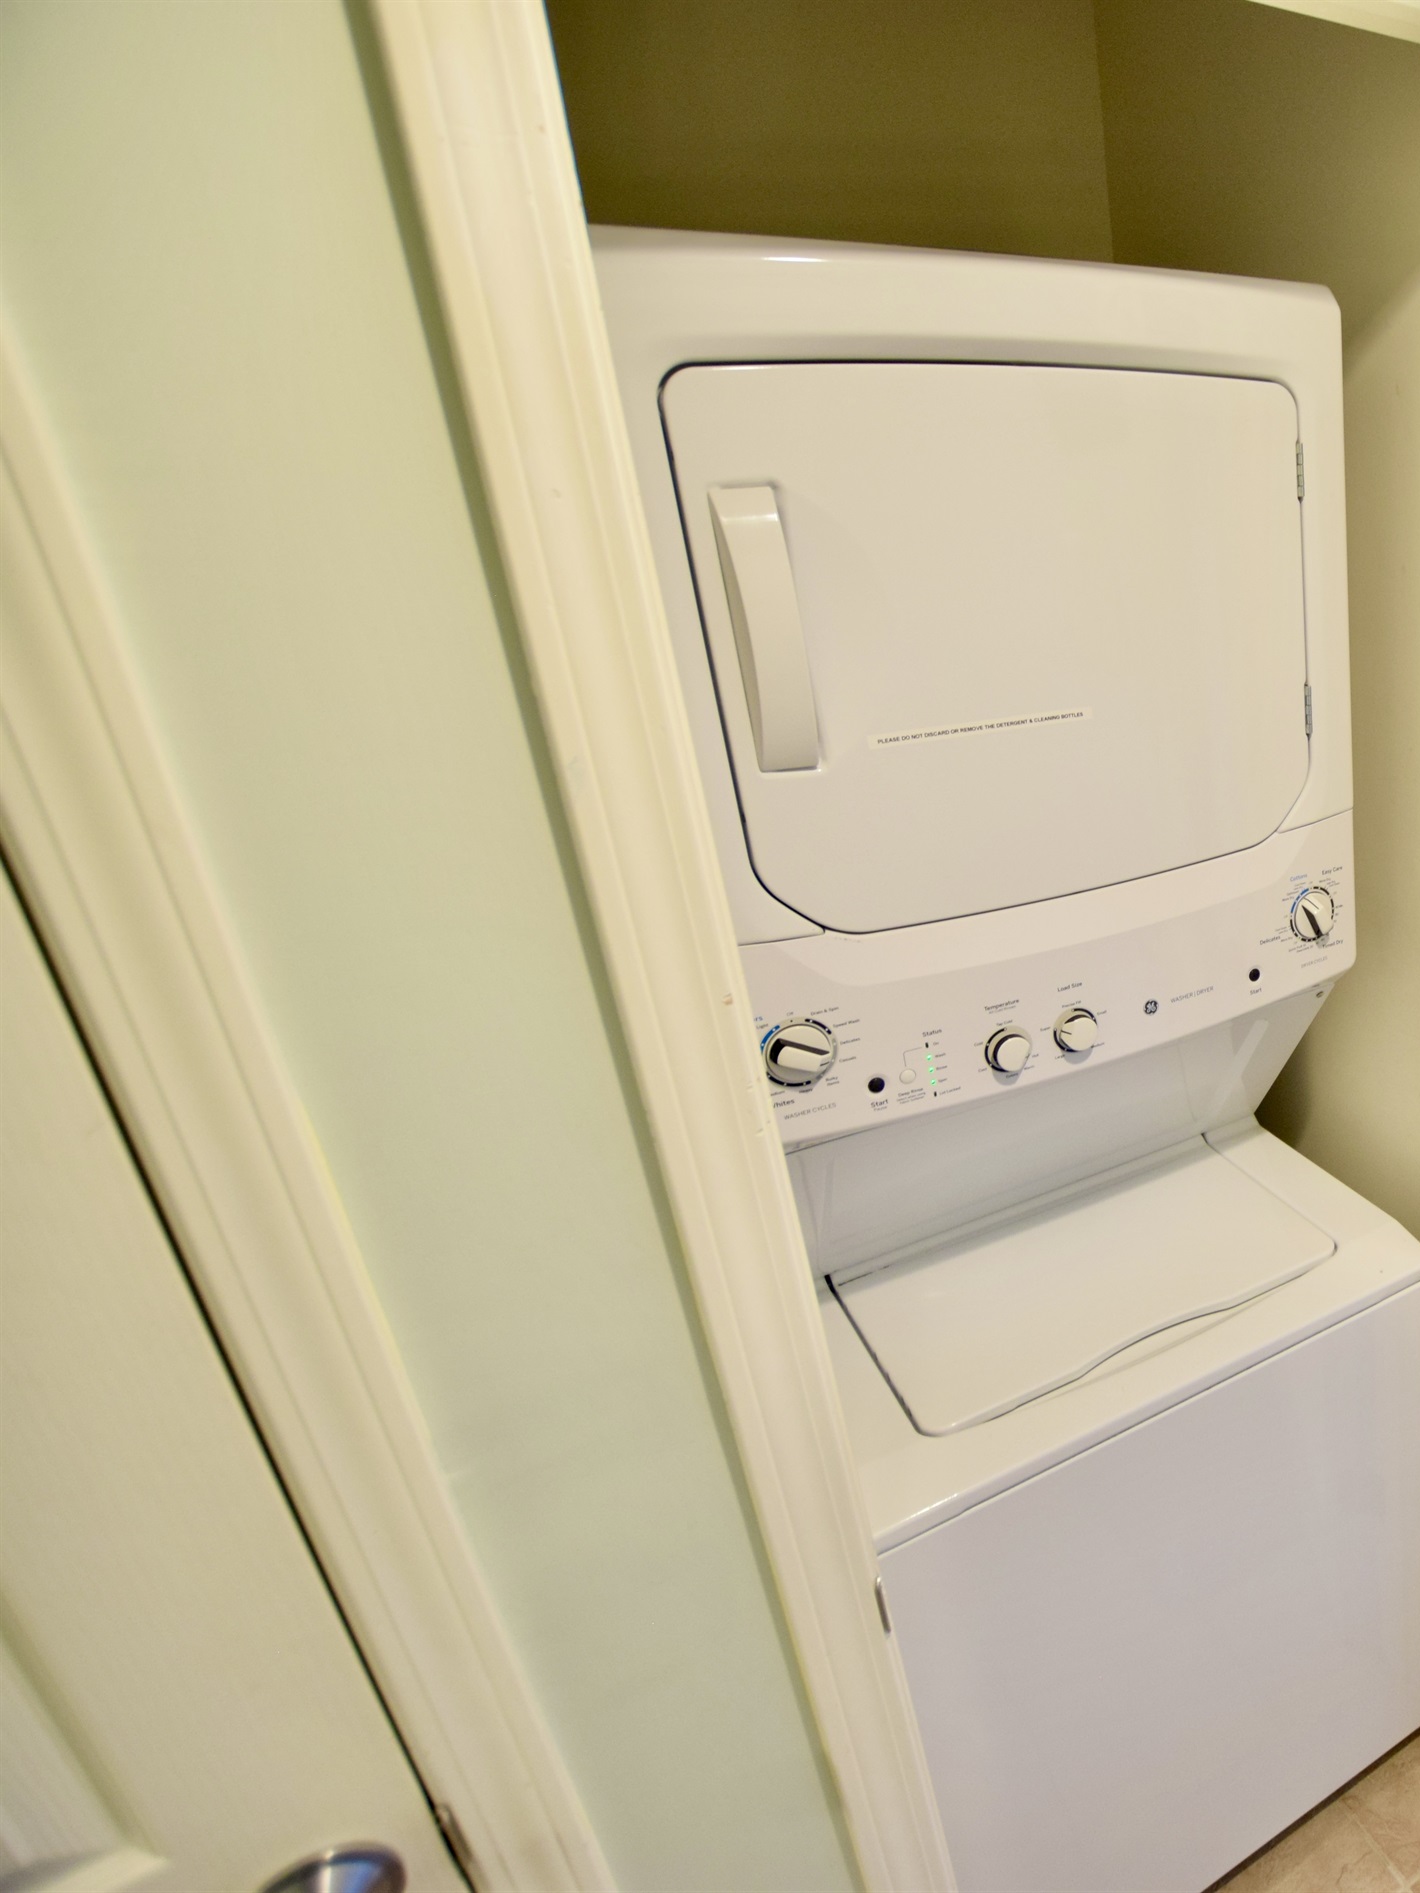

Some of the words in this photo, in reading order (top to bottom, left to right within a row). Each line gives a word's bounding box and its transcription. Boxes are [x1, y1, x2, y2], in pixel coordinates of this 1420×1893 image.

[877, 736, 900, 745] PLEASE
[924, 729, 950, 738] DISCARD
[960, 725, 983, 733] REMOVE
[996, 718, 1028, 729] DETERGENT
[1033, 714, 1060, 723] CLEANING
[1061, 712, 1083, 720] BOTTLES
[1290, 874, 1308, 882] Cottons
[1260, 935, 1281, 945] Delicates
[1170, 992, 1194, 1004] WASHER
[1196, 985, 1214, 996] DRYER
[1250, 987, 1262, 995] Start
[984, 999, 1020, 1011] Temperature
[922, 1029, 942, 1037] Status
[870, 1099, 888, 1109] Start
[784, 1108, 811, 1120] WASHER
[811, 1102, 837, 1114] CYCLES
